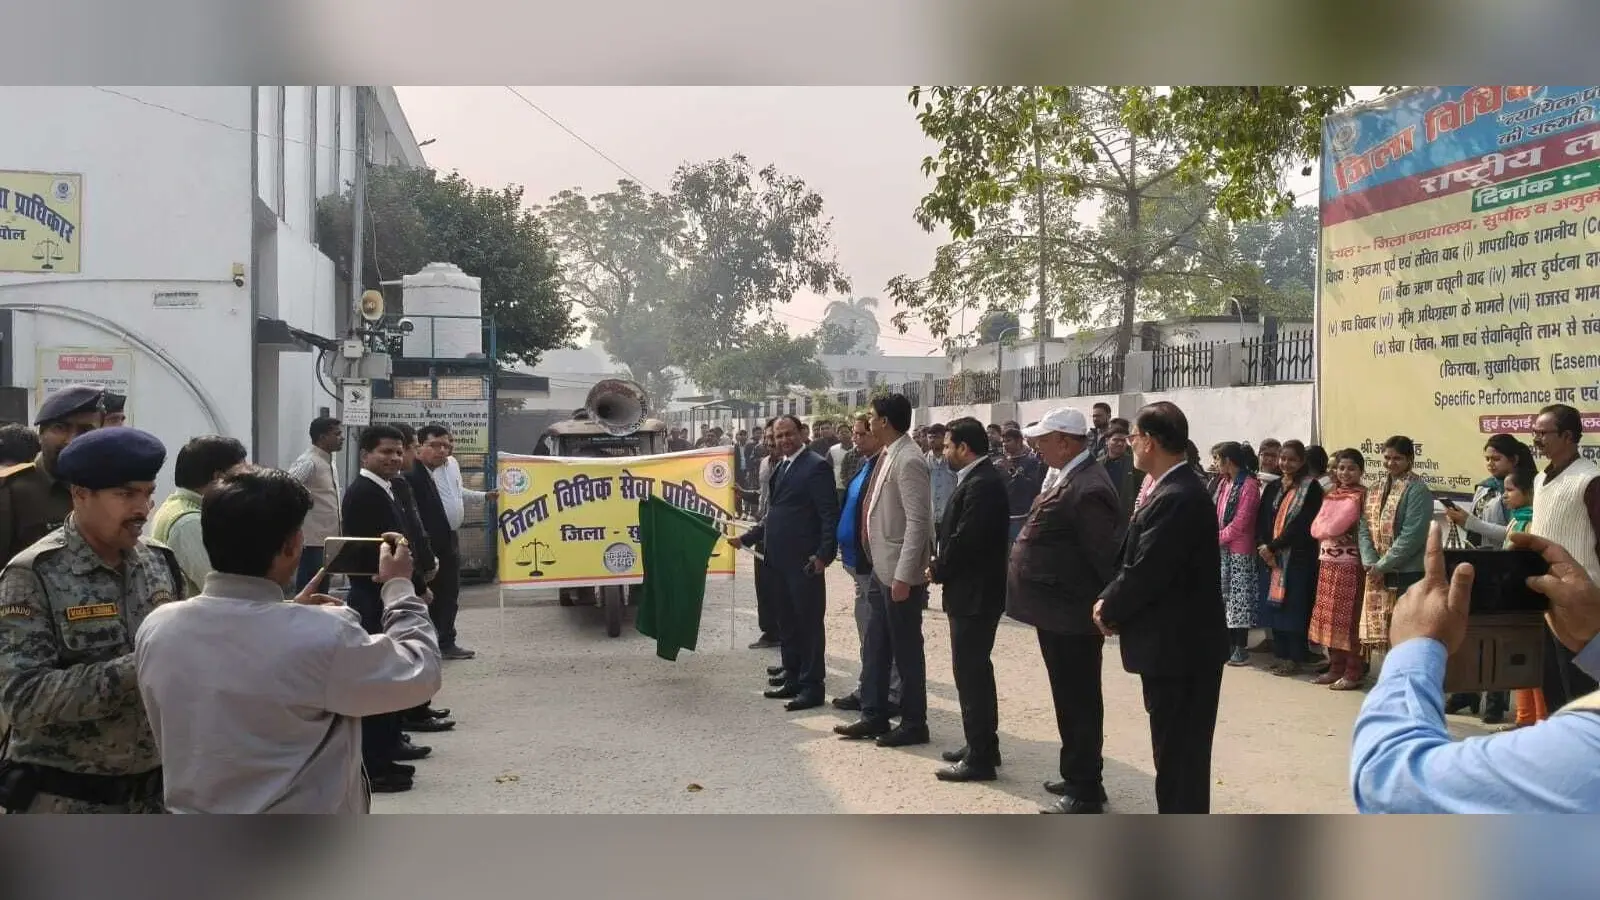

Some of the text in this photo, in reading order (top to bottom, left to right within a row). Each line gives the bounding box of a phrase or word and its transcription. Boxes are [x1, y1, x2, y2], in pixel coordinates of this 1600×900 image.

[1333, 124, 1416, 192] जिला
[1419, 146, 1545, 193] राष्ट्रीय
[15, 192, 75, 244] प्राधिकार
[1373, 234, 1405, 252] जिला
[1384, 253, 1397, 278] पूर्व
[1442, 246, 1460, 262] वाद
[1477, 230, 1530, 256] आपराधिक
[1534, 220, 1577, 244] शमनीय
[1437, 269, 1464, 295] वसूली
[1466, 270, 1485, 287] वाद
[1489, 265, 1506, 287] (iv)
[1511, 259, 1538, 279] मोटर
[1541, 252, 1580, 281] दुर्घटना
[1354, 314, 1377, 332] विवाद
[1397, 307, 1414, 330] भूमि
[1417, 303, 1458, 323] अधिग्रहण
[1461, 297, 1471, 316] के
[1475, 292, 1505, 315] मामले
[1509, 292, 1530, 317] (vii)
[1535, 289, 1570, 308] राजस्व
[1388, 335, 1406, 354] सेवा
[1441, 333, 1459, 350] भत्ता
[1462, 327, 1478, 346] एवं
[1537, 322, 1561, 339] लाभ
[1566, 315, 1577, 336] से
[1484, 354, 1541, 380] सुखाधिकार
[1434, 380, 1599, 410] Specific Performance वाद एवं
[1361, 438, 1373, 455] श्री
[499, 494, 549, 544] जिला
[553, 473, 613, 512] विधिक
[619, 469, 655, 501] सेवा
[560, 524, 606, 541] जिला
